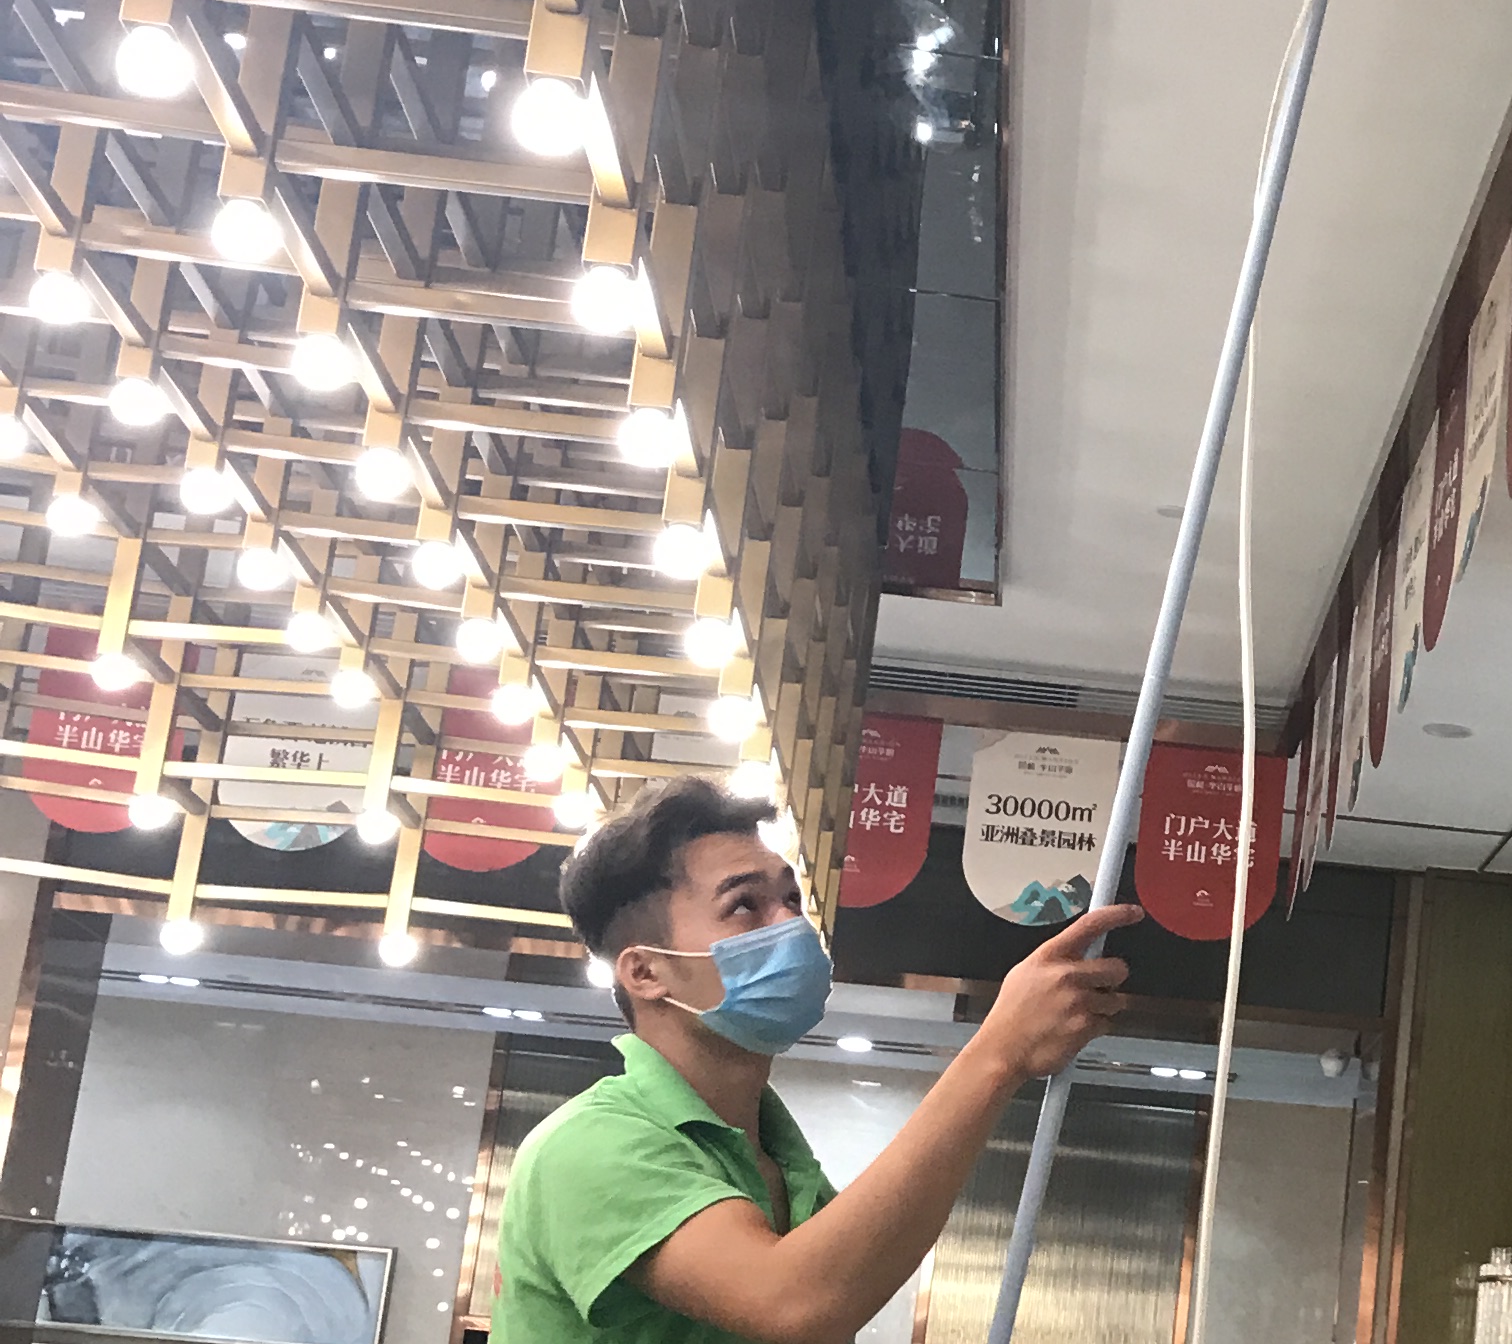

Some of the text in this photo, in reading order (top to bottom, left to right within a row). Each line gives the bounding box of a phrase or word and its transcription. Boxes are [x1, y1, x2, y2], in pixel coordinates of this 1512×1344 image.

[853, 782, 909, 809] 大道
[984, 793, 1098, 824] 30000m²
[848, 806, 906, 835] 华宅
[979, 823, 1098, 852] 亚洲叠景园林
